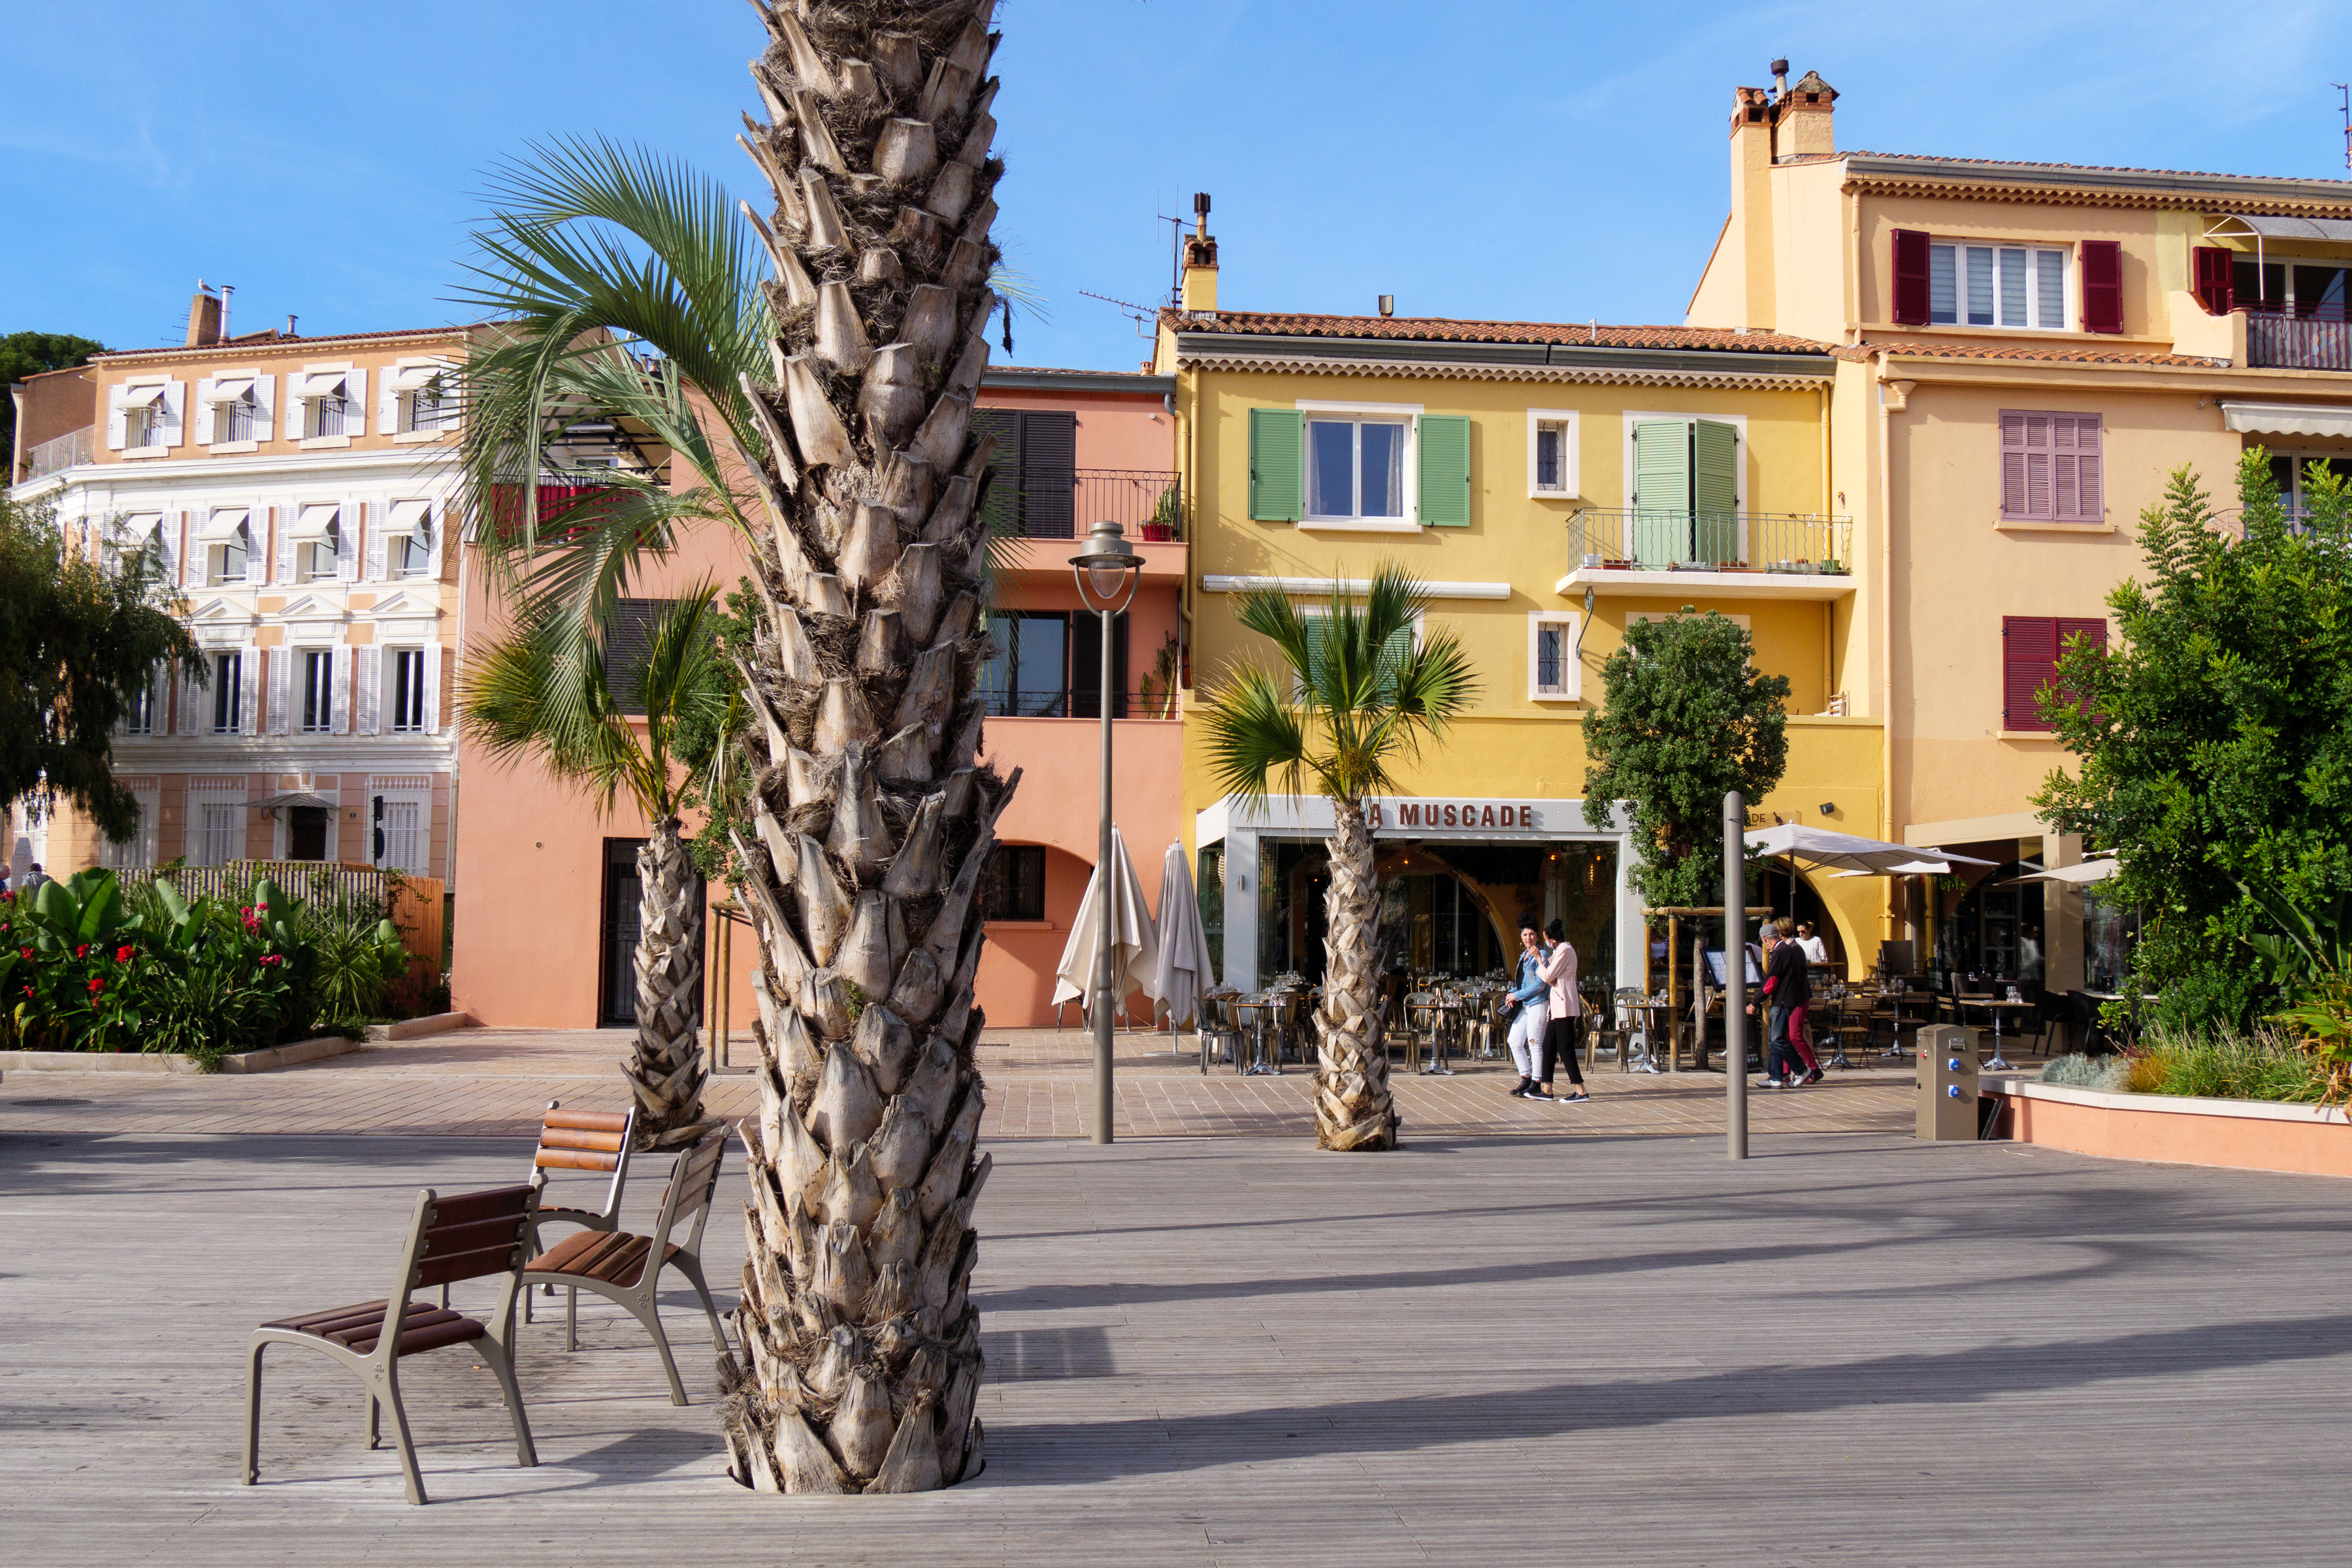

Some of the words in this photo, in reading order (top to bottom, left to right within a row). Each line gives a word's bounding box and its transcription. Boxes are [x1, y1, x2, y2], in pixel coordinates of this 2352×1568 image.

[1368, 804, 1383, 825] A
[1399, 804, 1531, 827] MUSCADE
[1752, 813, 1766, 823] DE
